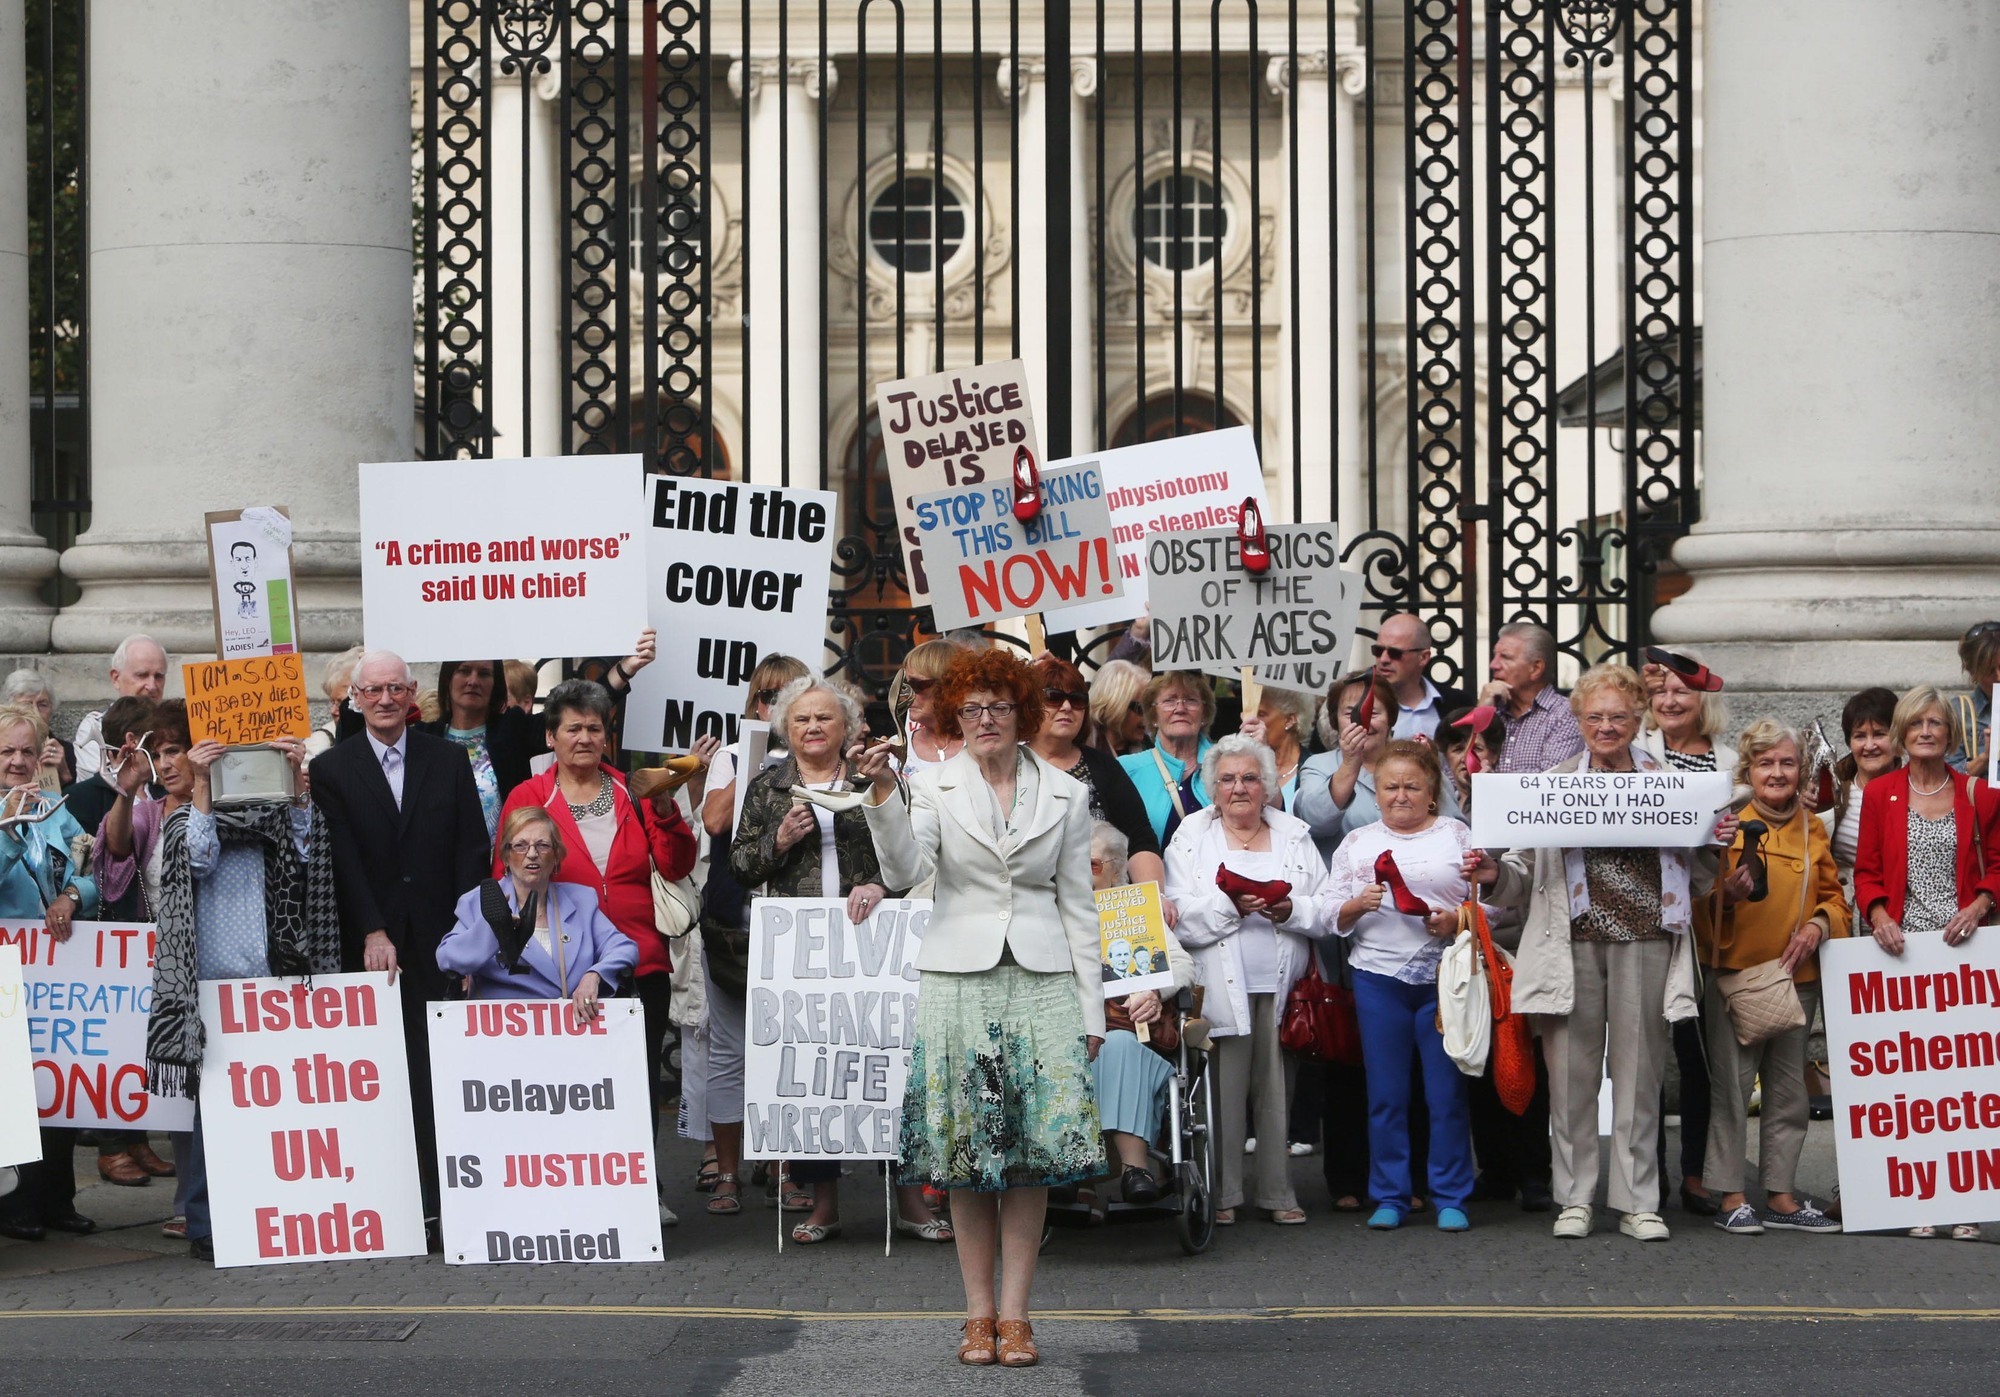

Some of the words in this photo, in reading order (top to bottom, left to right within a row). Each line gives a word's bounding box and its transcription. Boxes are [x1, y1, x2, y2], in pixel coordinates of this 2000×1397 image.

[903, 418, 1027, 469] DELAYED
[943, 454, 986, 487] IS
[652, 479, 739, 536] End
[749, 490, 827, 544] the
[916, 491, 986, 532] STOP
[991, 469, 1100, 518] BLCKING
[951, 522, 1013, 558] THIS
[1024, 510, 1082, 547] BILL
[1148, 506, 1242, 533] sleeples
[407, 539, 482, 566] crime
[488, 537, 535, 564] and
[1150, 530, 1335, 577] OBSTERICS
[421, 574, 475, 603] said
[482, 575, 516, 602] UN
[521, 571, 588, 600] chief
[664, 561, 804, 613] cover
[958, 536, 1115, 619] NOW!
[1201, 579, 1241, 608] OF
[1249, 575, 1314, 606] THE
[226, 642, 255, 652] LADIES!
[242, 626, 257, 635] LEO
[1152, 613, 1237, 664] DARK
[1247, 609, 1338, 660] AGES
[697, 637, 758, 686] up
[190, 667, 195, 696] I
[215, 691, 263, 713] BABY
[226, 722, 294, 744] LATER
[232, 712, 244, 730] 7
[1520, 776, 1540, 789] 64
[1547, 776, 1606, 789] YEARS
[1613, 776, 1636, 789] OF
[1644, 776, 1685, 789] PAIN
[1541, 794, 1555, 806] IF
[1563, 793, 1609, 807] ONLY
[1615, 793, 1620, 807] I
[1627, 794, 1665, 807] HAD
[1507, 811, 1597, 824] CHANGED
[1602, 812, 1627, 824] MY
[1632, 811, 1698, 825] SHOES!
[1096, 896, 1146, 911] DELAYED
[1099, 887, 1142, 903] JUSTICE
[1103, 916, 1146, 930] JUSTICE
[1117, 909, 1127, 920] IS
[1105, 925, 1147, 939] DENIED
[96, 930, 156, 969] IT!
[218, 983, 377, 1034] Listen
[465, 1003, 607, 1037] JUSTICE
[1849, 1031, 2000, 1077] schem
[228, 1061, 282, 1108] to
[292, 1053, 380, 1104] the
[462, 1077, 615, 1115] Delayed
[271, 1127, 355, 1183] UN,
[446, 1155, 483, 1188] IS
[503, 1152, 648, 1188] JUSTICE
[1887, 1156, 1937, 1200] by
[1947, 1148, 2000, 1194] UN
[255, 1203, 384, 1259] Enda
[487, 1228, 621, 1262] Denied
